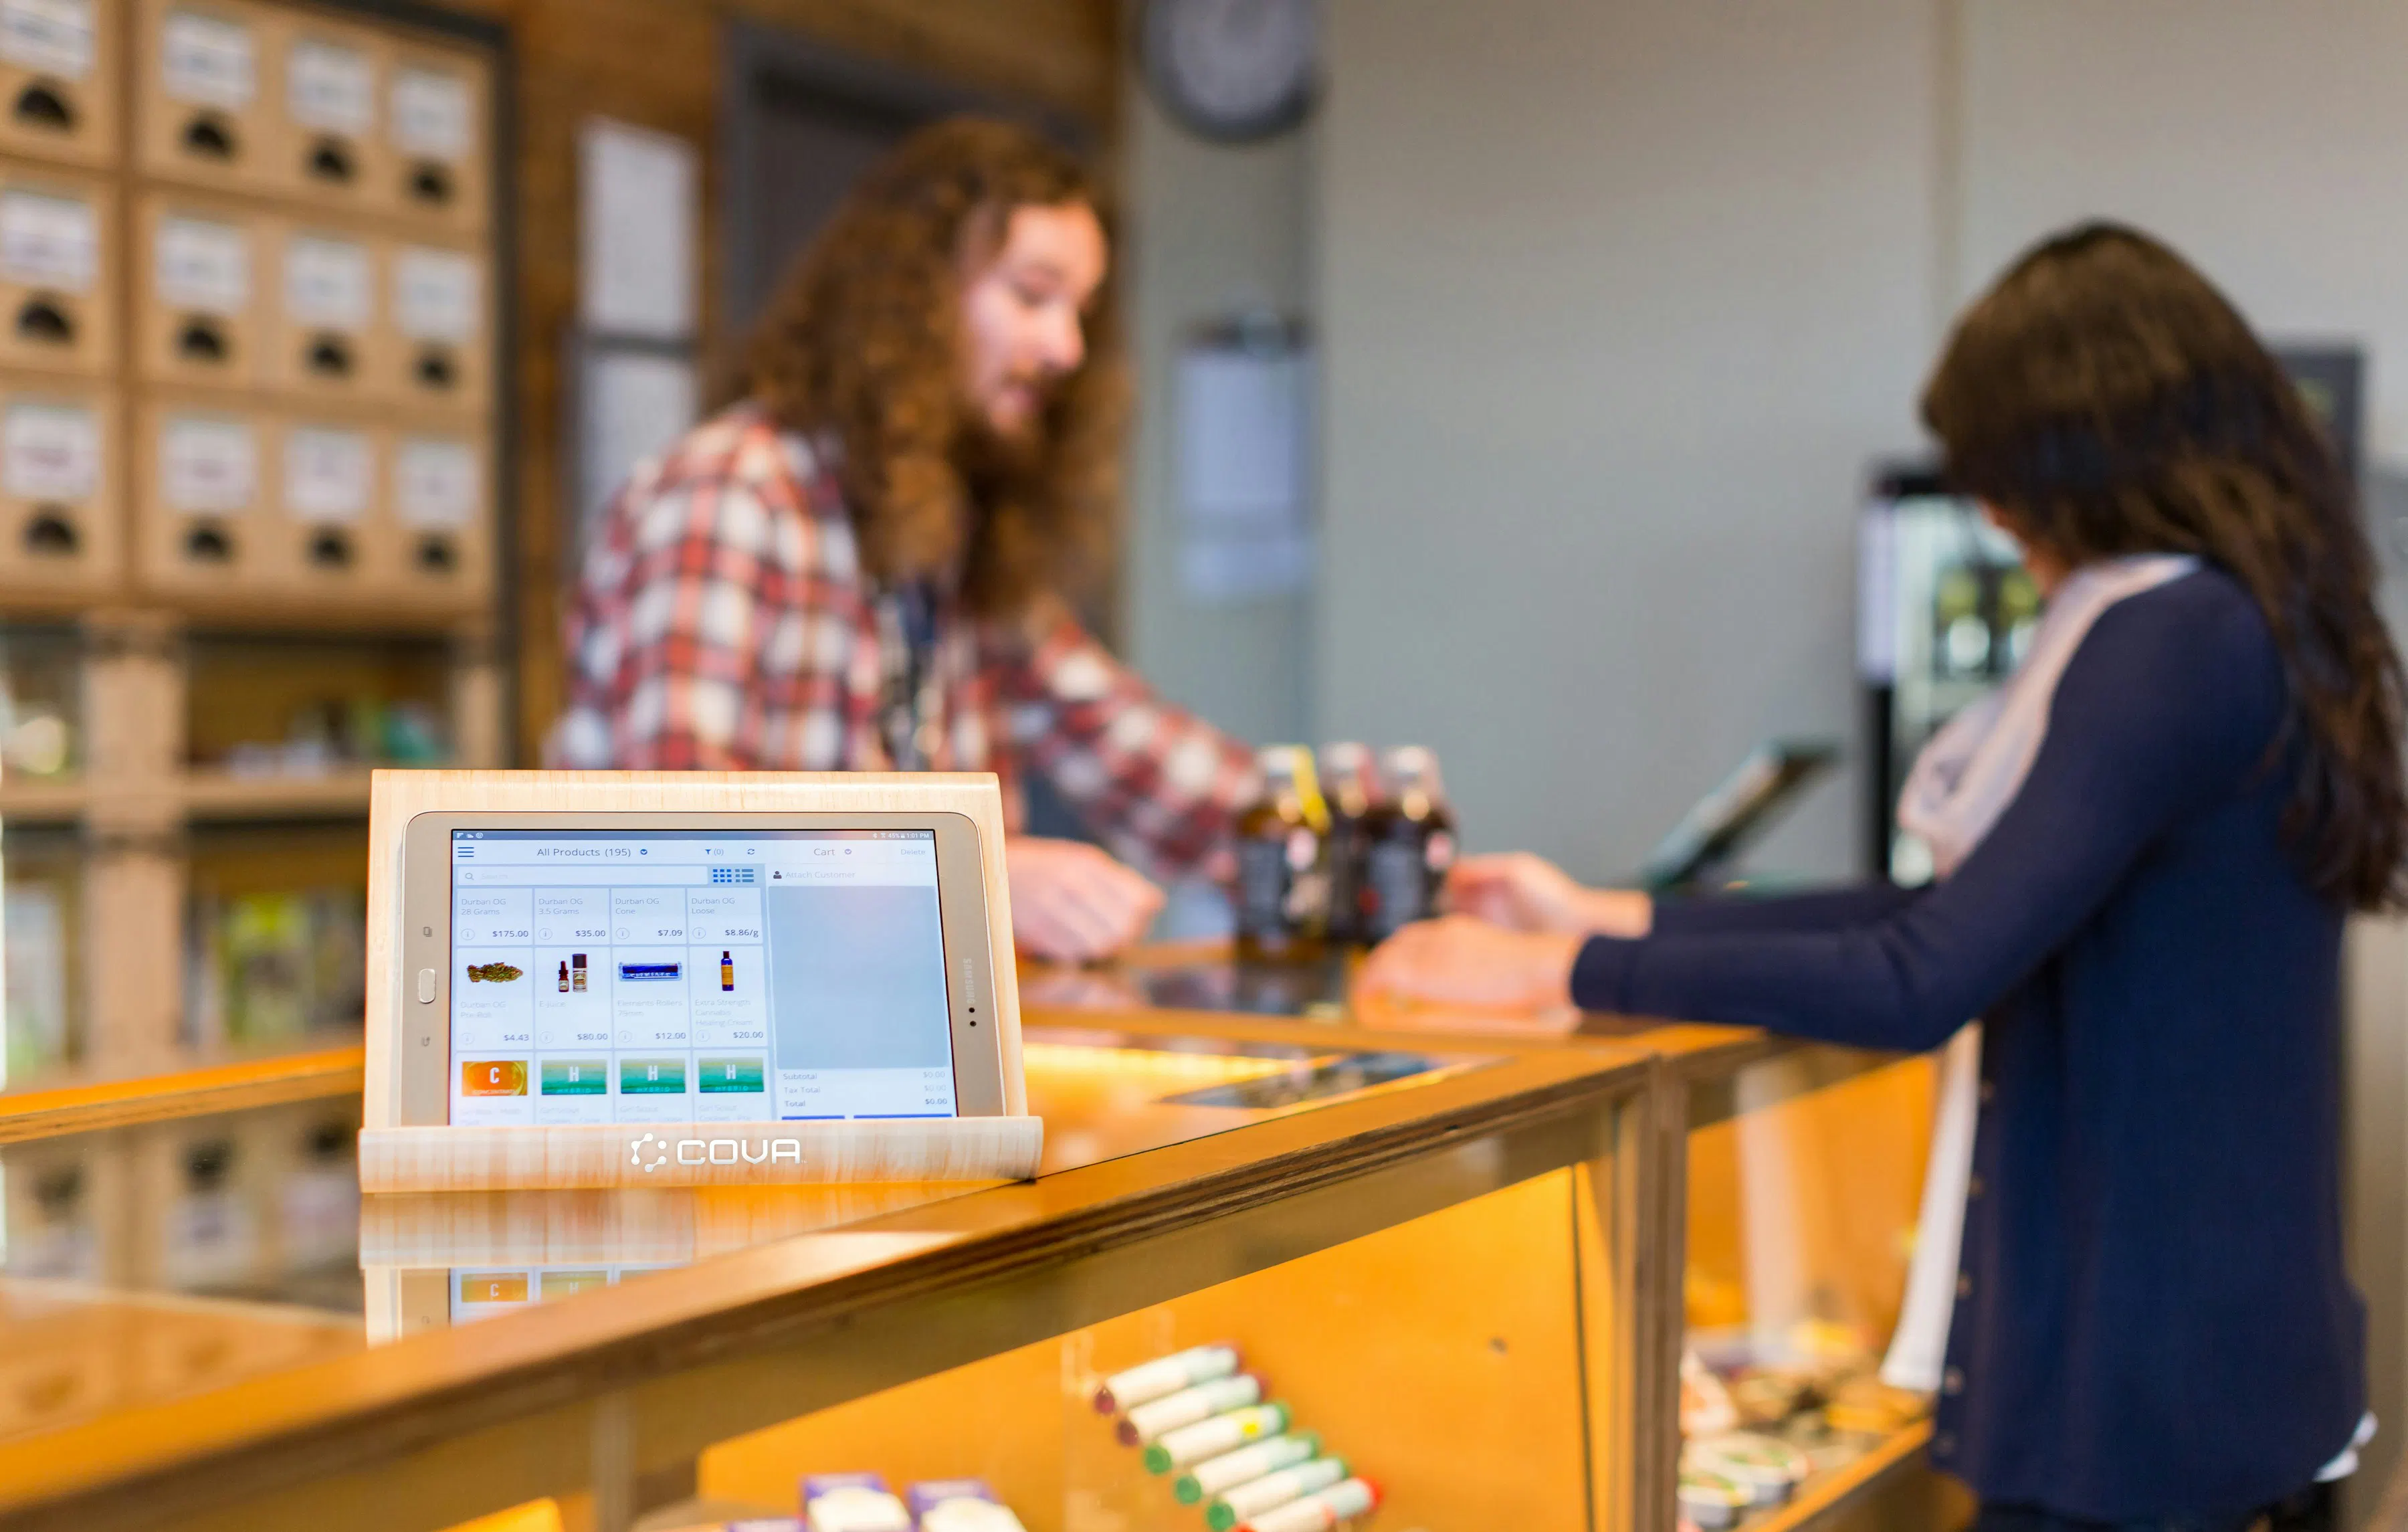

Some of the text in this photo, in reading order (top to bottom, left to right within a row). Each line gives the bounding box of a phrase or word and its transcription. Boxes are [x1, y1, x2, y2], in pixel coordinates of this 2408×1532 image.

[537, 848, 631, 858] All Products (195)
[814, 848, 835, 856] Cart
[725, 929, 759, 938] $8.86/g
[963, 958, 975, 1004] SAMSUNG
[716, 999, 751, 1008] Strength
[489, 1067, 500, 1084] C
[569, 1066, 580, 1082] H
[647, 1065, 658, 1081] H
[726, 1064, 736, 1080] H
[677, 1139, 801, 1165] COVA
